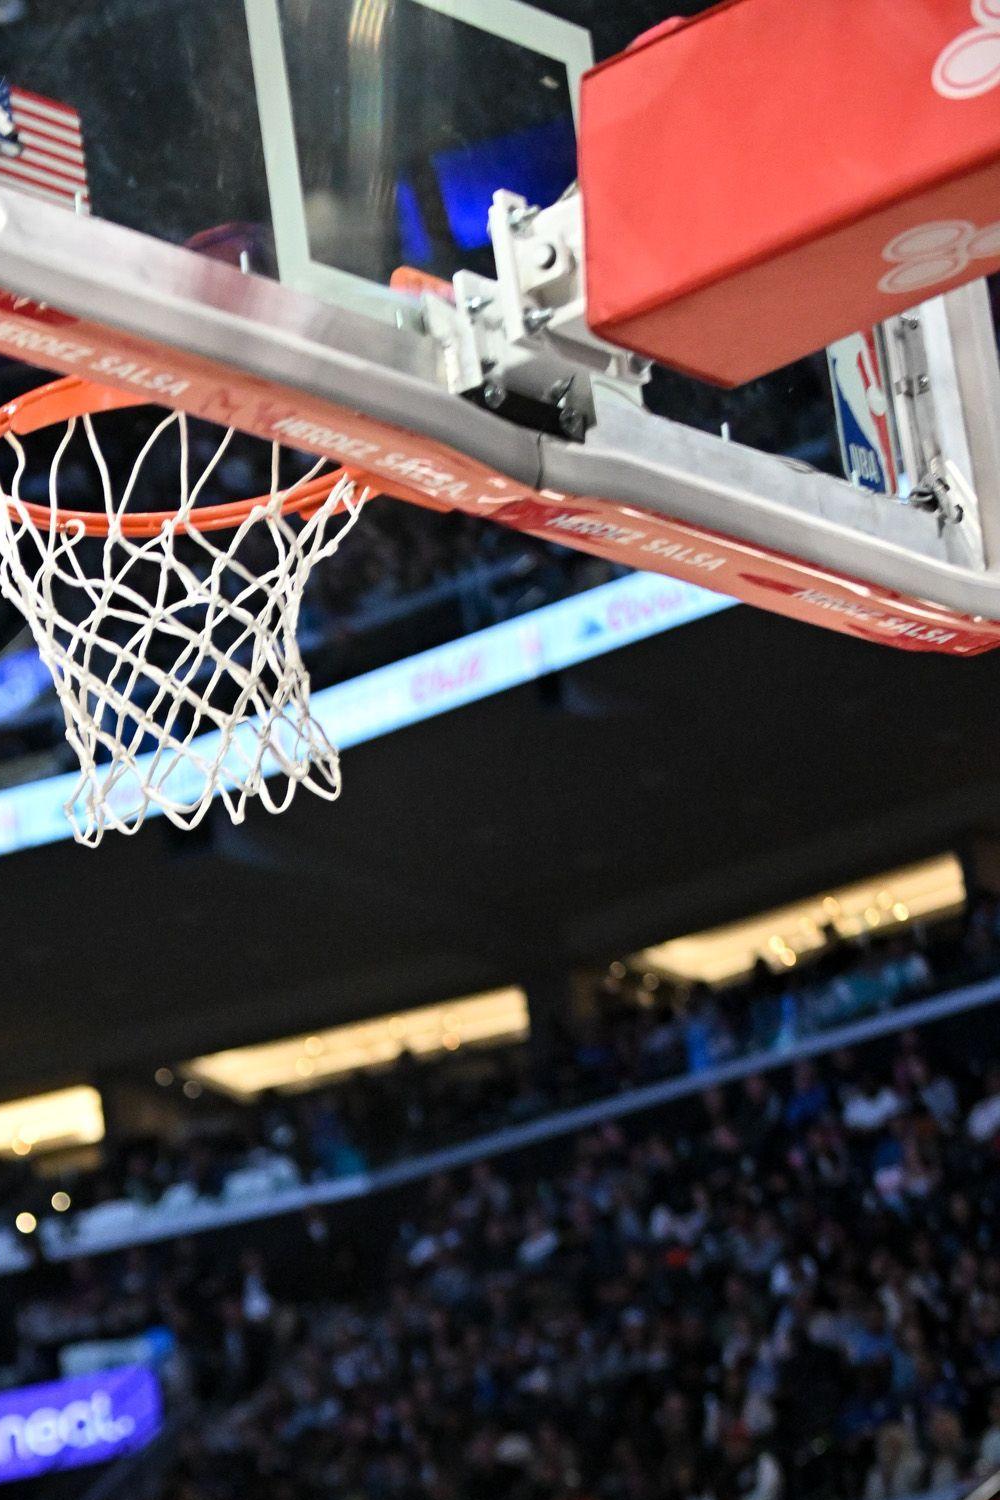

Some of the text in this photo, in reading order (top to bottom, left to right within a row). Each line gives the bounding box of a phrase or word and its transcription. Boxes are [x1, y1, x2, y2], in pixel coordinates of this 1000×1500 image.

[90, 355, 192, 397] SALSA
[640, 536, 728, 571] SALSA
[876, 616, 957, 645] SALSA
